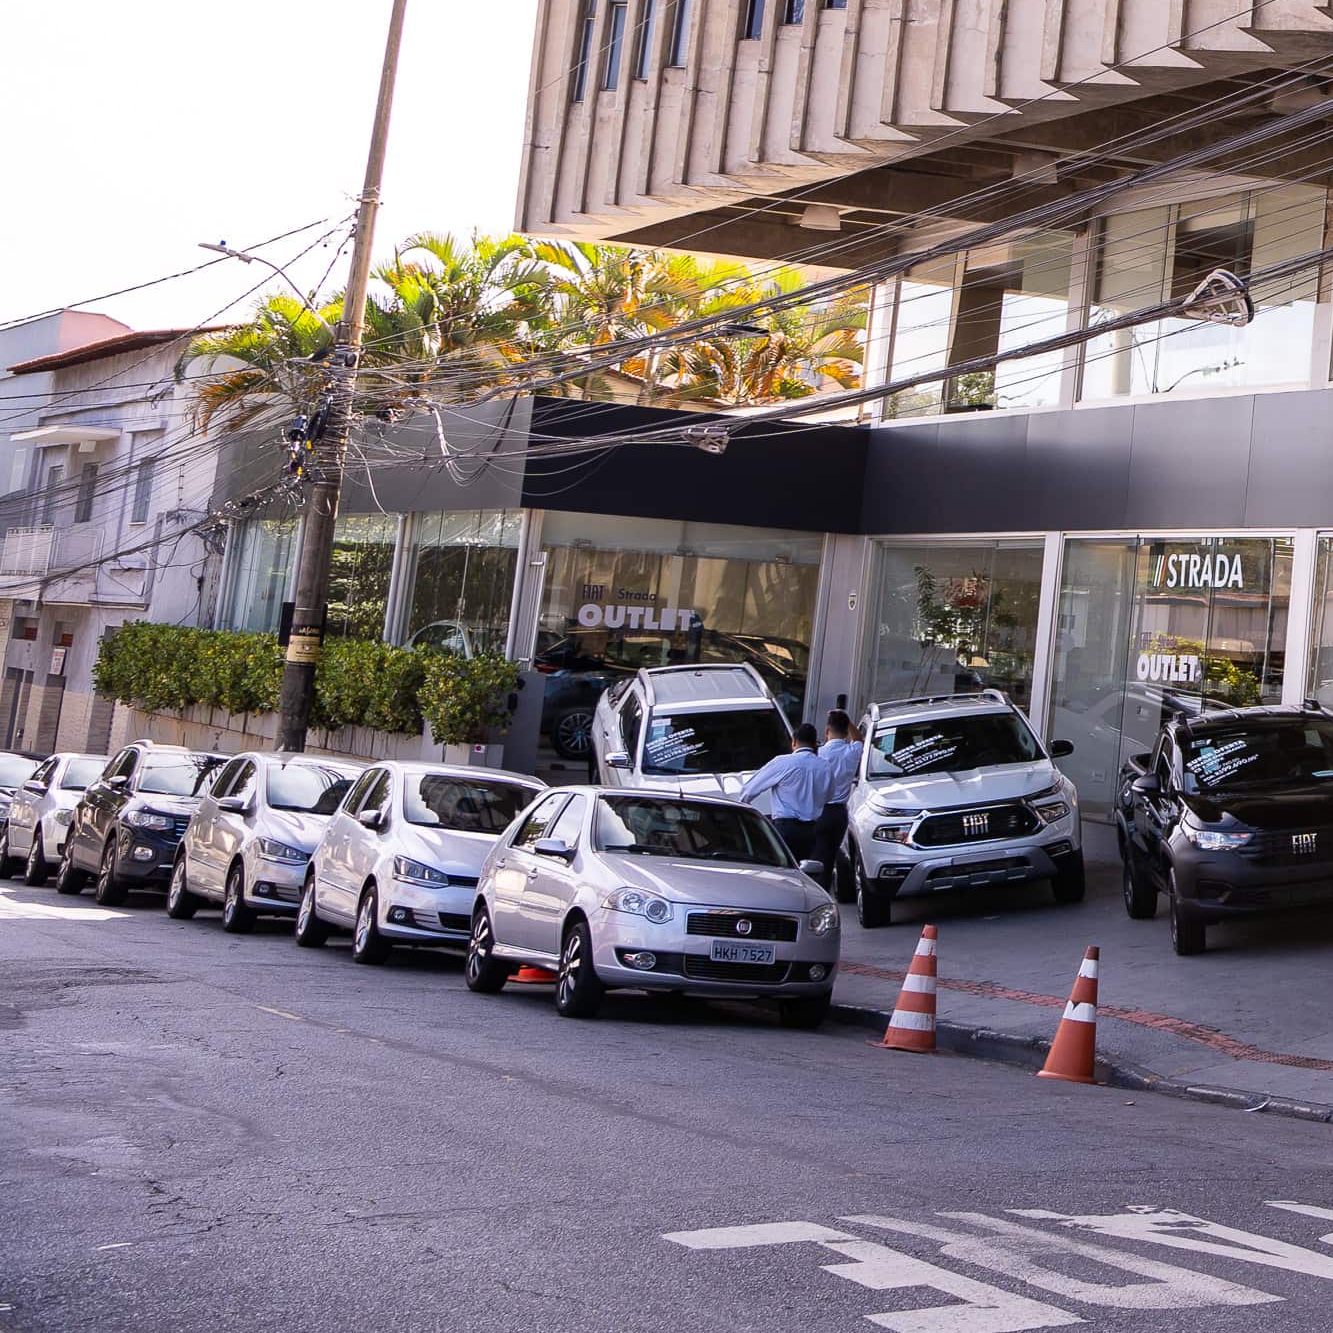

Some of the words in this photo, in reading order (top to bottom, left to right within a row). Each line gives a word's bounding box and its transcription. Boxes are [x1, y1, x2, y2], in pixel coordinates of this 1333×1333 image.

[1167, 553, 1244, 589] STRADA
[583, 584, 605, 601] FIAT
[618, 588, 657, 602] Strada
[578, 603, 693, 631] OUTLET
[1137, 654, 1198, 682] OUTLET
[1186, 752, 1214, 767] SUPER
[1214, 739, 1246, 755] OFERTA
[962, 812, 990, 836] FIAT
[1292, 832, 1318, 854] FIAT
[714, 947, 738, 961] HKH
[742, 948, 772, 963] 7527
